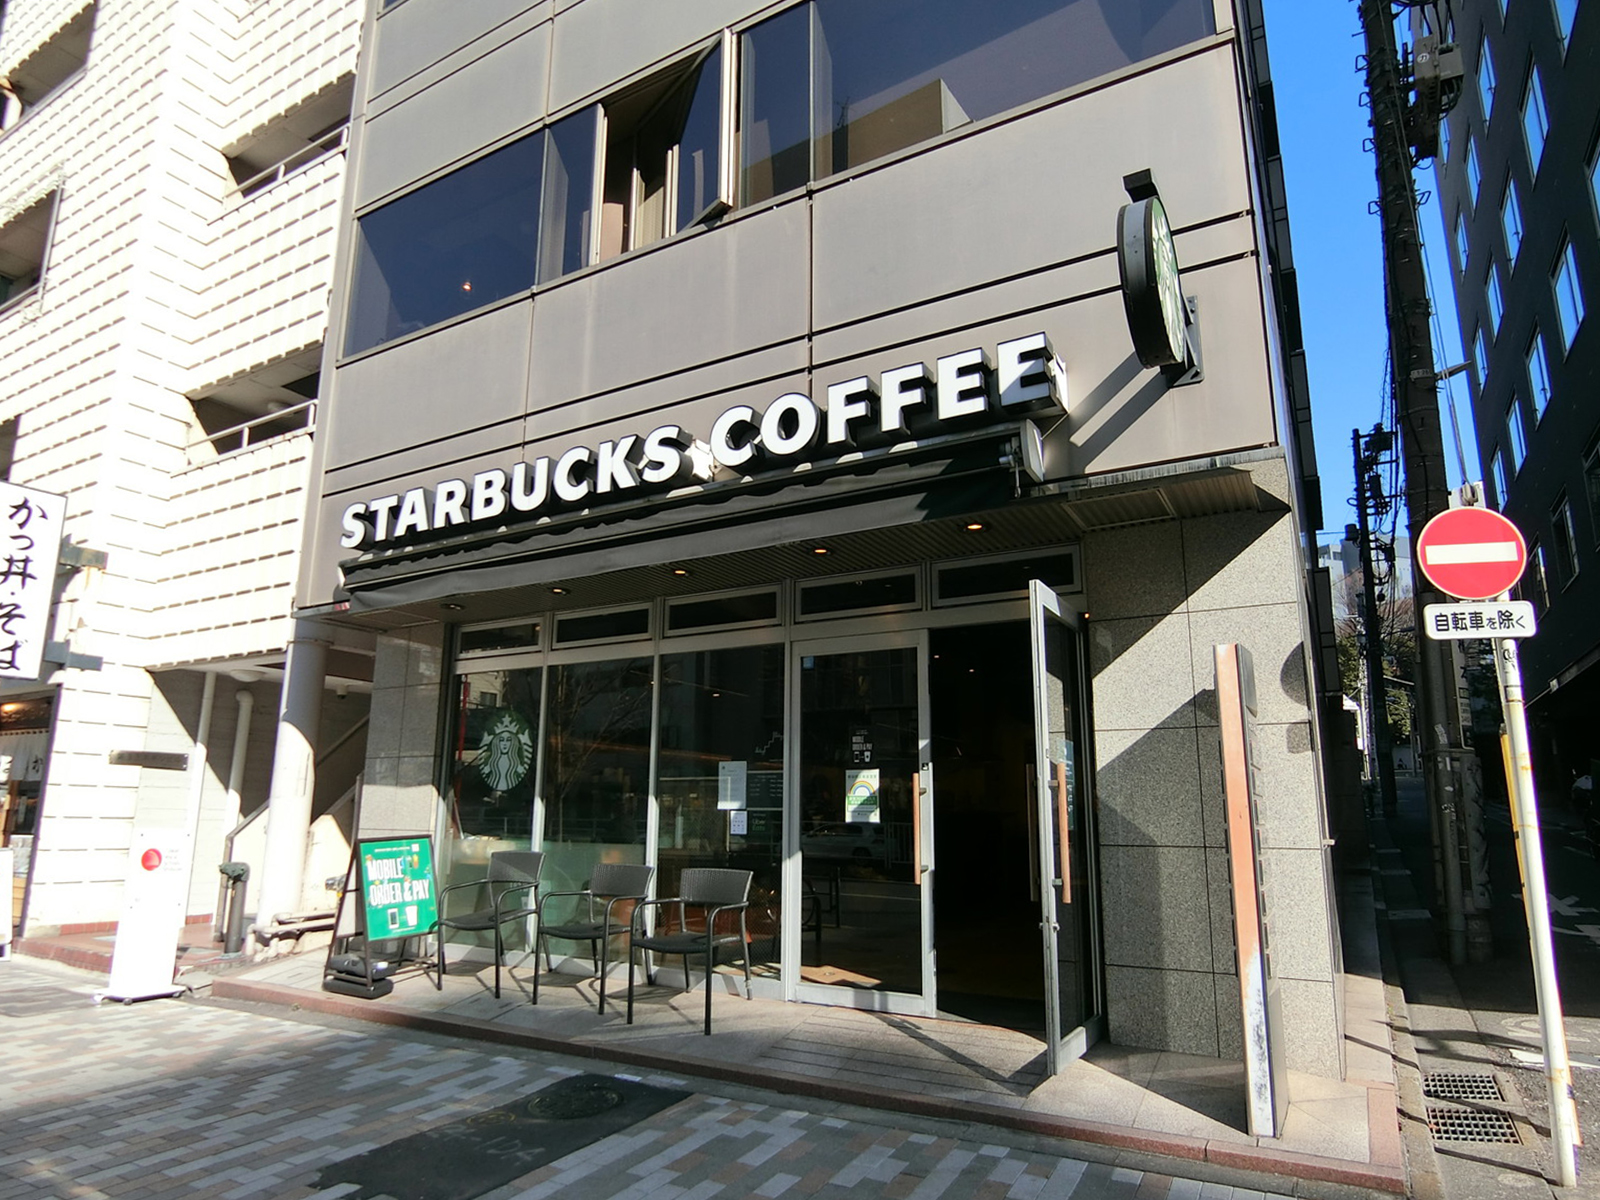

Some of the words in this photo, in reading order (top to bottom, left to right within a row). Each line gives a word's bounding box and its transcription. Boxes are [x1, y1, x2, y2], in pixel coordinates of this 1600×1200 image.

[341, 425, 683, 549] STARBUCKS
[710, 332, 1052, 467] COFFEE
[1434, 610, 1526, 632] 自転車を除く
[367, 857, 404, 881] MOBILE
[370, 882, 403, 906] ORDER
[403, 880, 413, 901] &
[412, 879, 430, 900] PAY
